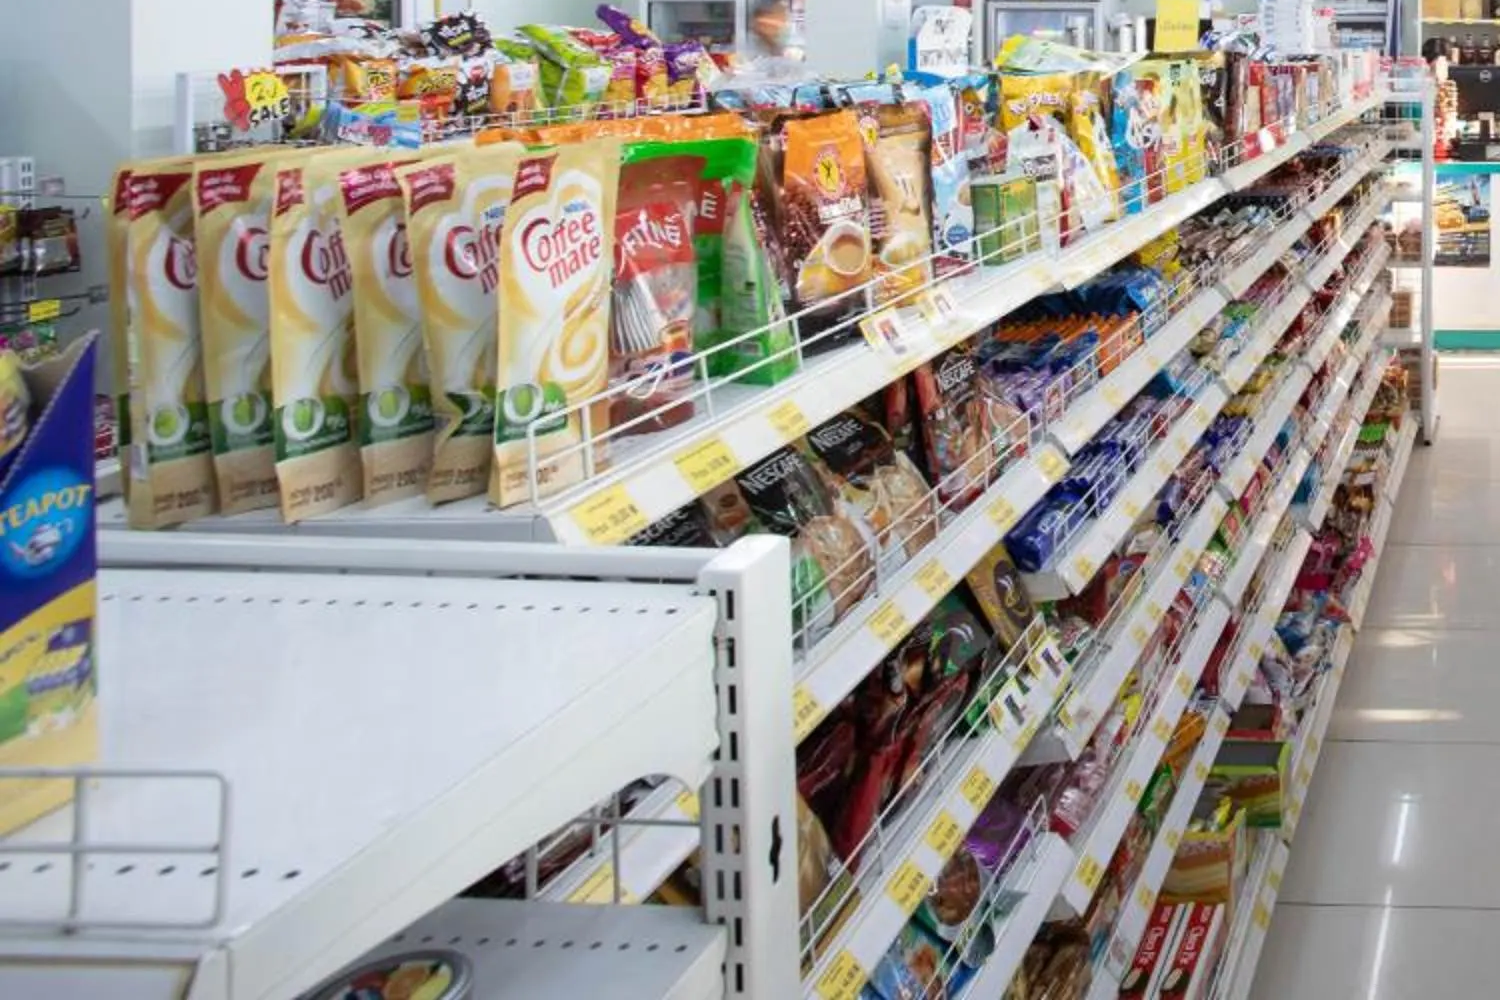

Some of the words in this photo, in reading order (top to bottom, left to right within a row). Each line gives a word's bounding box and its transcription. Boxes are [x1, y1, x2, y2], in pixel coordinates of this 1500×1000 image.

[248, 98, 291, 128] SALE
[301, 228, 348, 285] Coff
[445, 224, 503, 281] Coff
[521, 210, 595, 273] Coffee
[549, 235, 602, 289] mate
